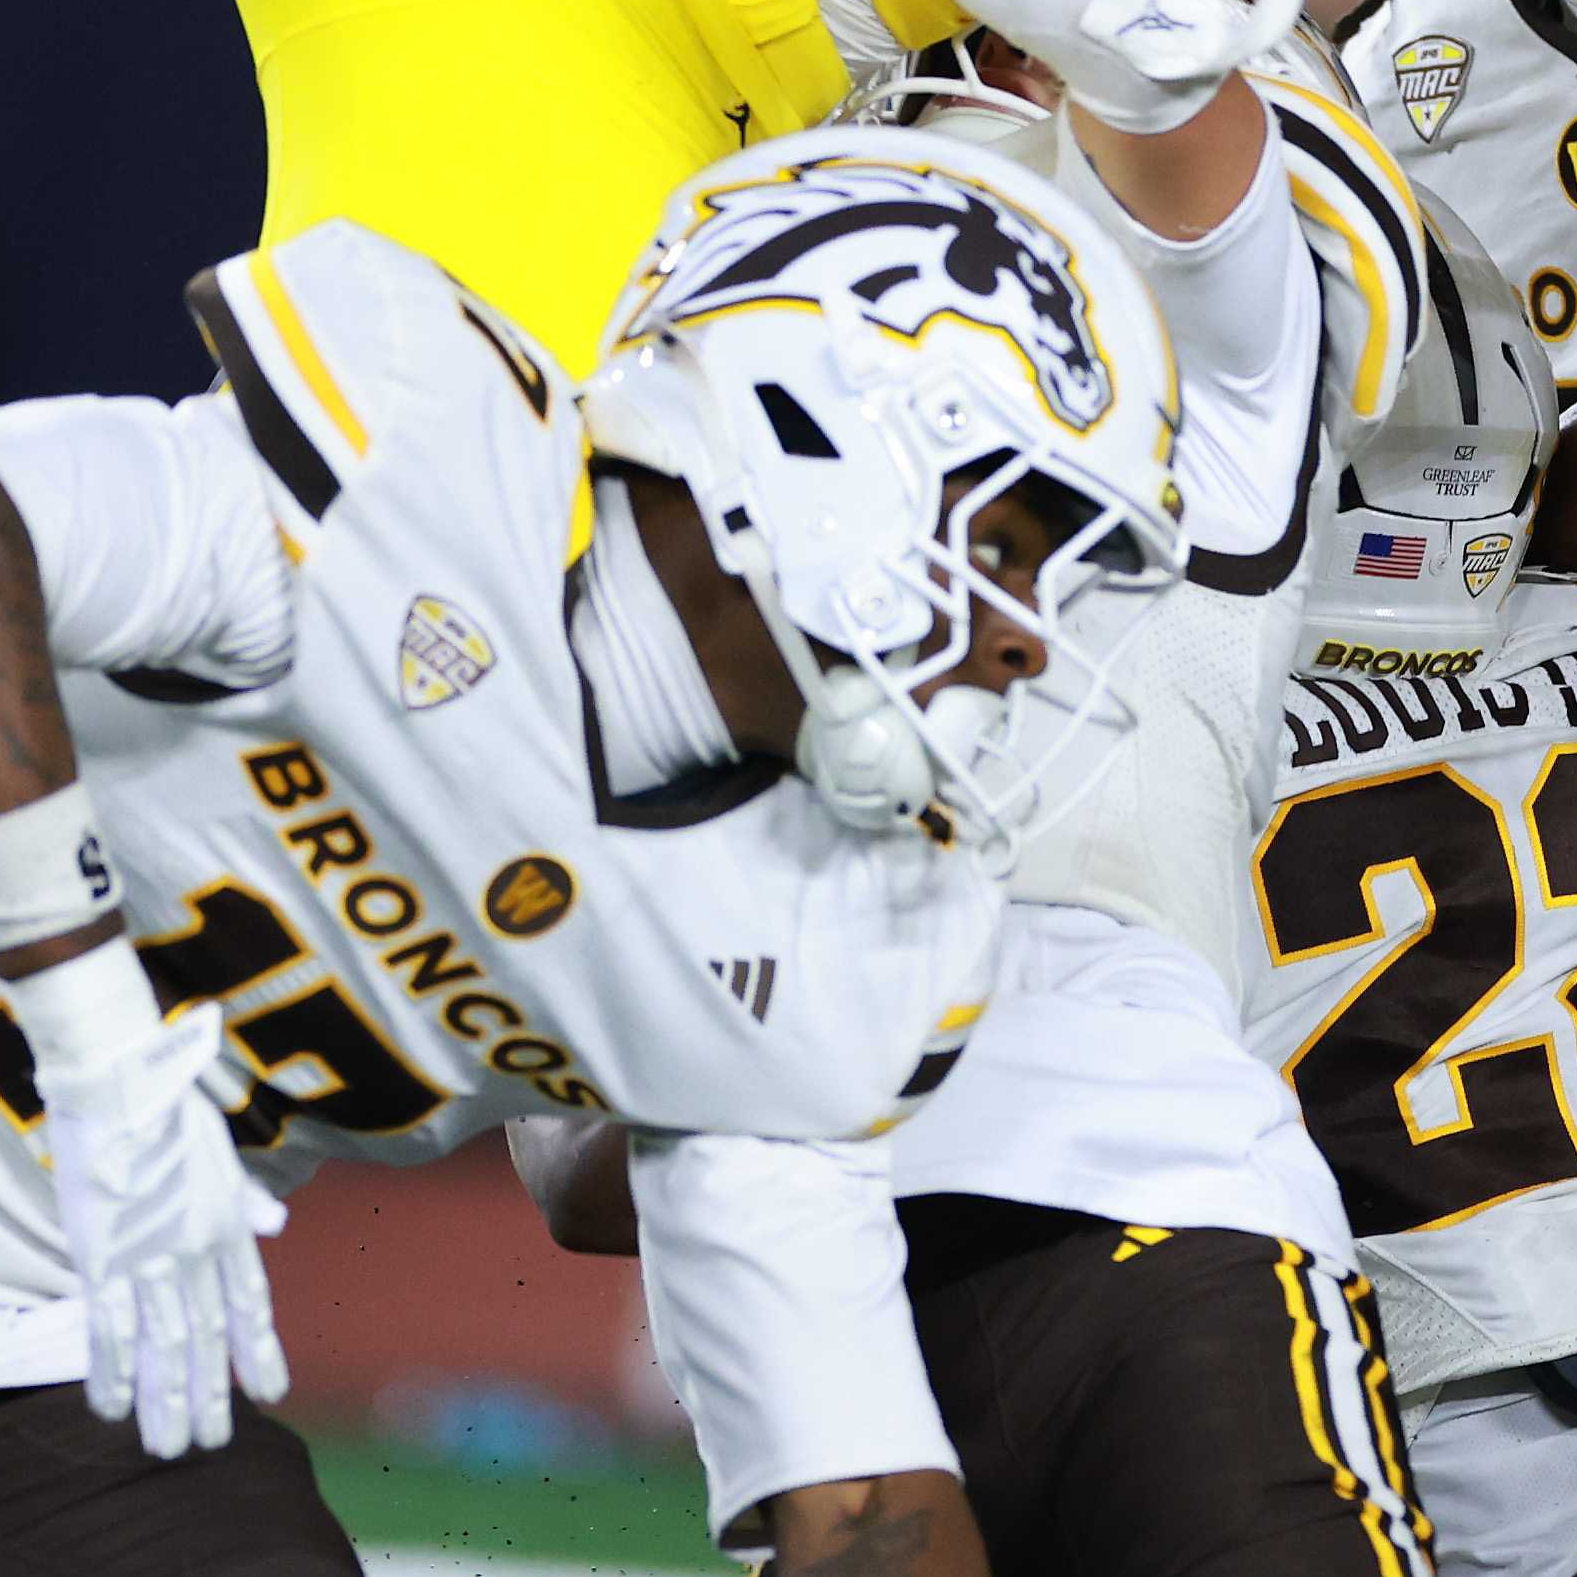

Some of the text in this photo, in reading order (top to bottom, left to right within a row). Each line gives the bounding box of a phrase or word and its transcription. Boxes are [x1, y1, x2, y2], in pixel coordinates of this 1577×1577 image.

[1399, 67, 1462, 100] MAC
[1422, 467, 1495, 484] GREENLEAF
[1435, 482, 1479, 497] TRUST
[1464, 550, 1508, 572] MAC
[1315, 638, 1485, 679] BRONCOS
[238, 741, 612, 1114] BRONCOS
